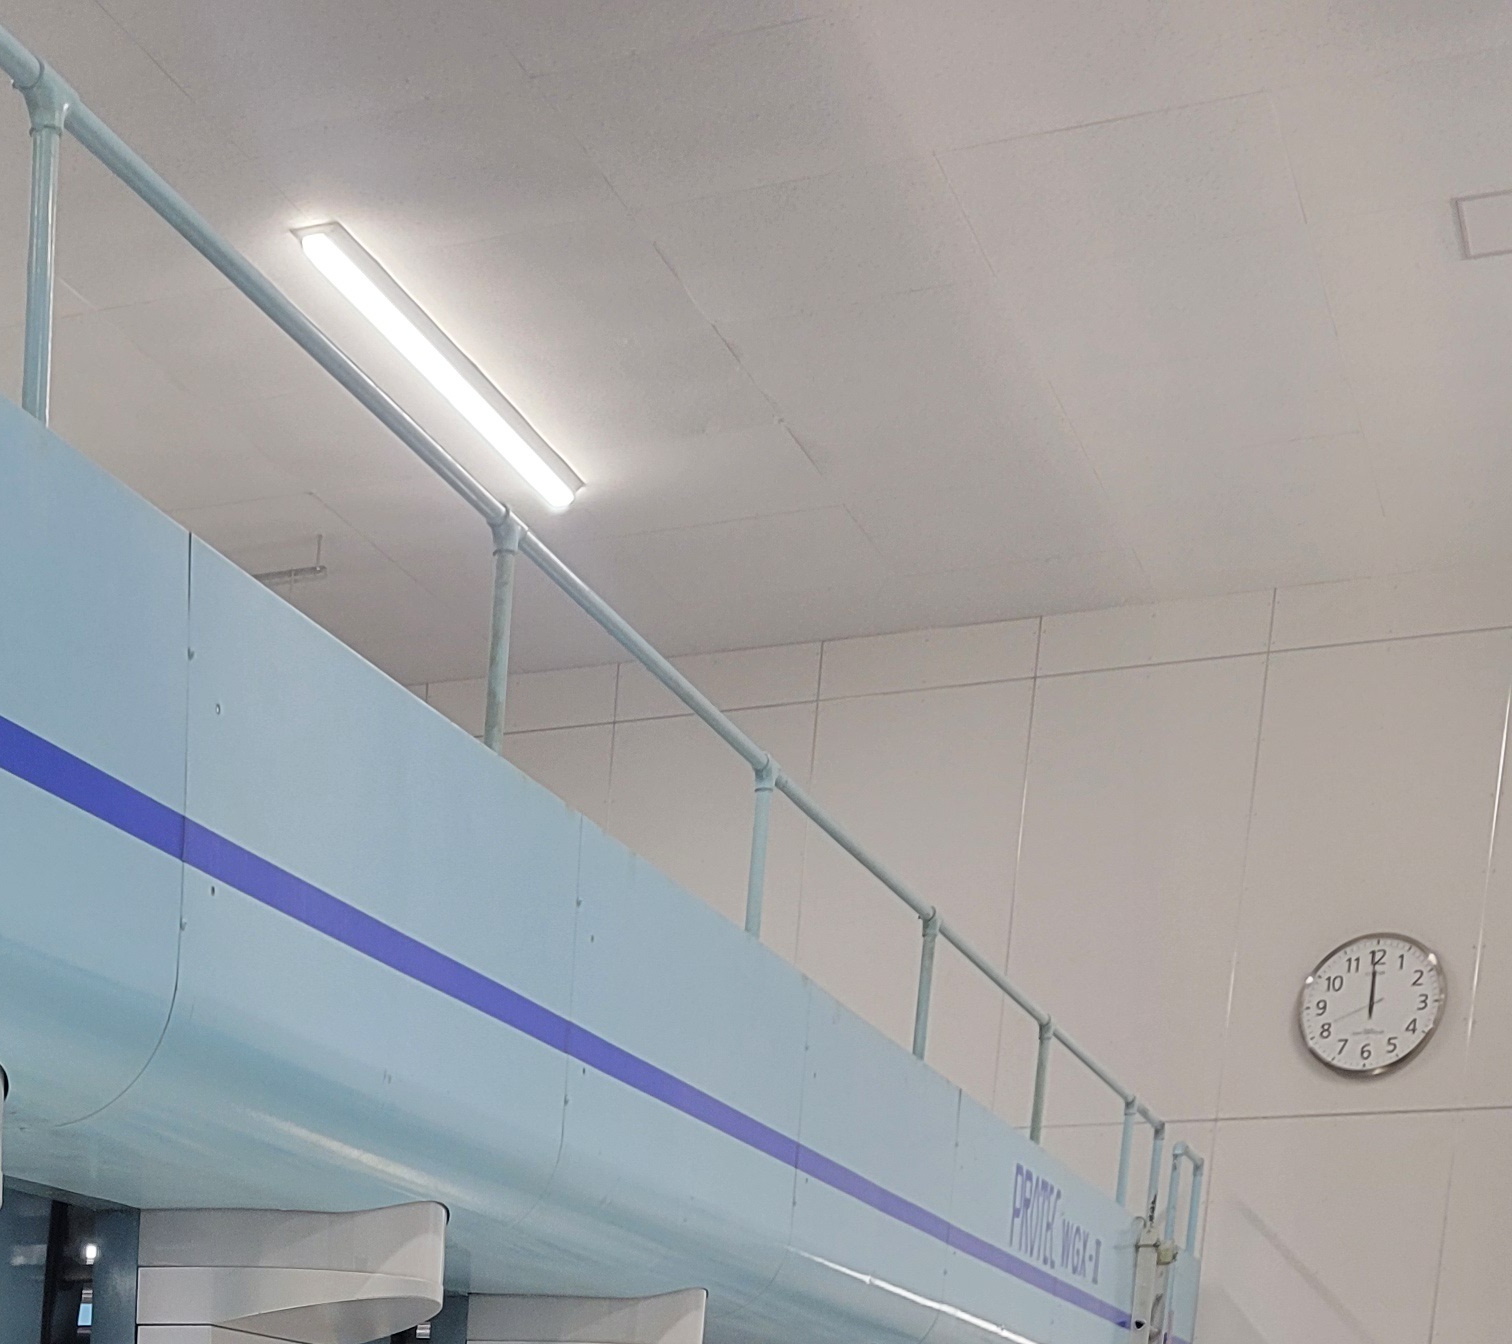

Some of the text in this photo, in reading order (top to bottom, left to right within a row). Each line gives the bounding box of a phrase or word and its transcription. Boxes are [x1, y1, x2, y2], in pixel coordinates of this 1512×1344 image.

[1346, 957, 1361, 973] 11
[1369, 949, 1387, 966] 12
[1398, 954, 1405, 970] 1
[1325, 975, 1344, 992] 10
[1411, 969, 1424, 986] 2
[1315, 1000, 1327, 1016] 9
[1417, 994, 1429, 1010] 3
[1320, 1022, 1332, 1039] 8
[1405, 1018, 1418, 1034] 4
[1338, 1039, 1349, 1055] 7
[1360, 1044, 1371, 1060] 6
[1386, 1037, 1398, 1053] 5
[1009, 1162, 1062, 1269] PROTEC
